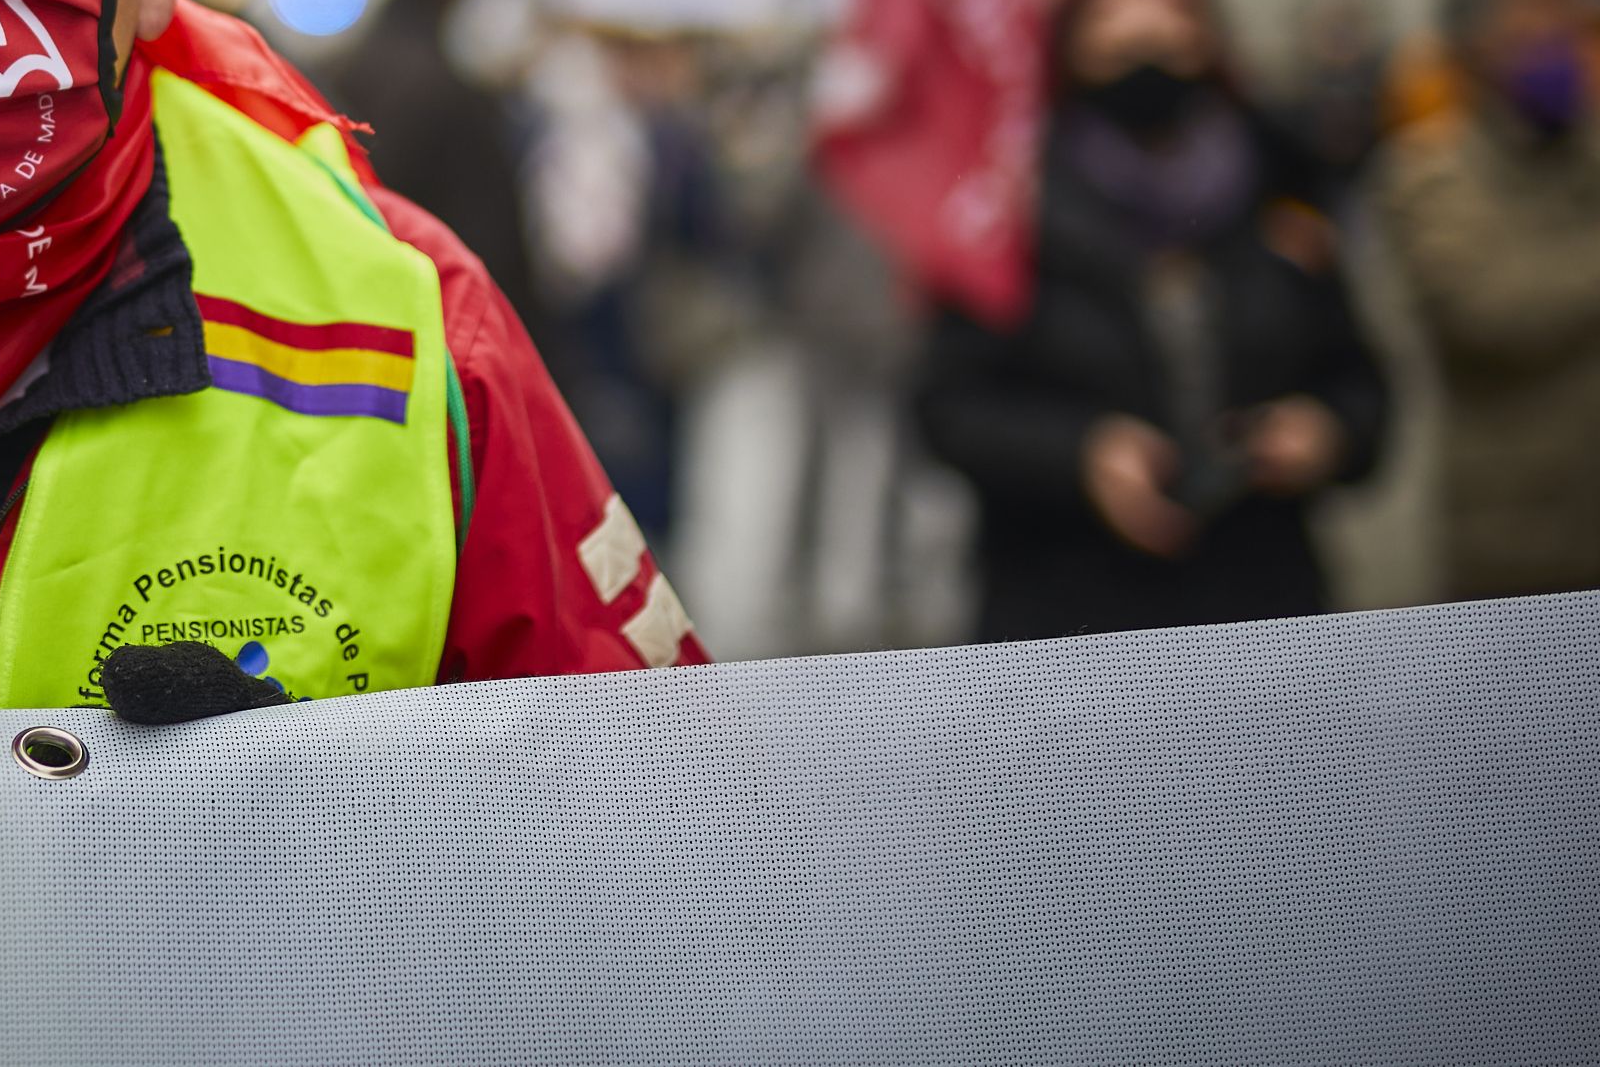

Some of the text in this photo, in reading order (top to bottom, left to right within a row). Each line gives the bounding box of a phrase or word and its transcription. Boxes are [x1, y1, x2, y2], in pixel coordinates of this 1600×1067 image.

[15, 150, 44, 180] DE
[37, 92, 57, 143] MAD
[78, 603, 139, 700] forma
[133, 546, 334, 619] Pensionistas
[335, 622, 361, 663] de
[142, 616, 306, 643] PENSIONISTAS
